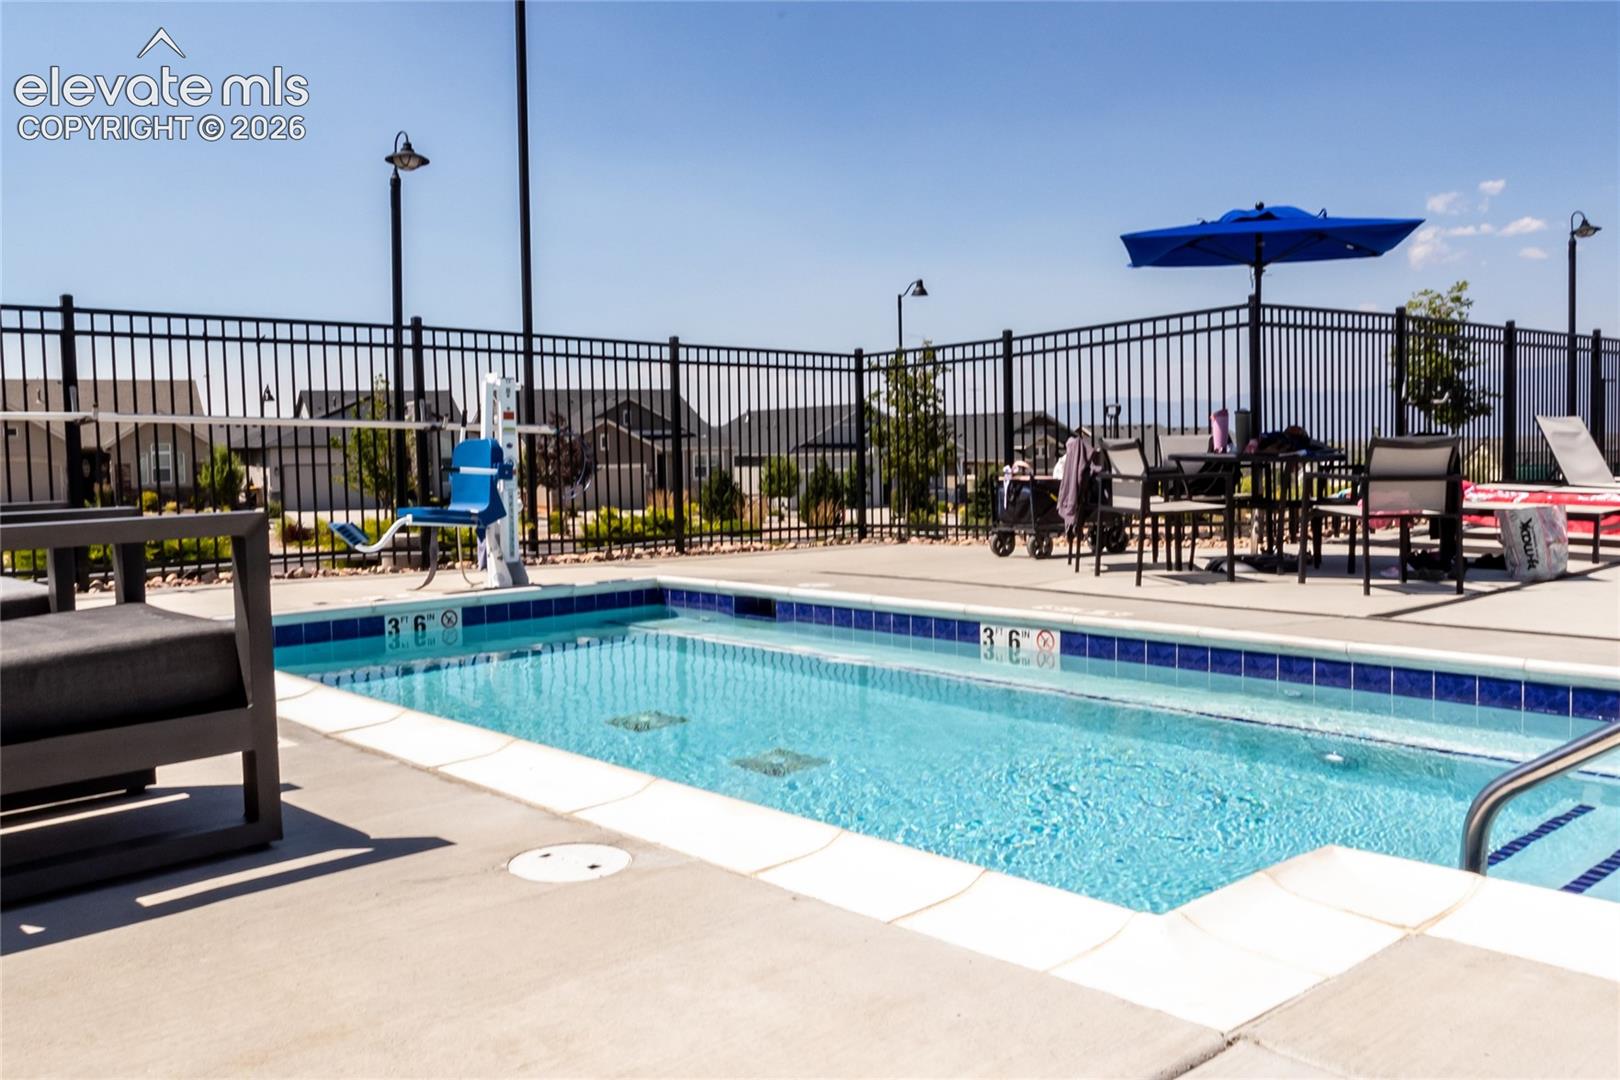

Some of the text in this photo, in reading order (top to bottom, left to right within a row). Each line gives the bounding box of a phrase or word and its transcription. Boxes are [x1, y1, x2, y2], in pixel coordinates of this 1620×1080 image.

[388, 617, 400, 635] 3
[413, 614, 426, 632] 6
[983, 626, 994, 646] 3
[1008, 629, 1020, 649] 6
